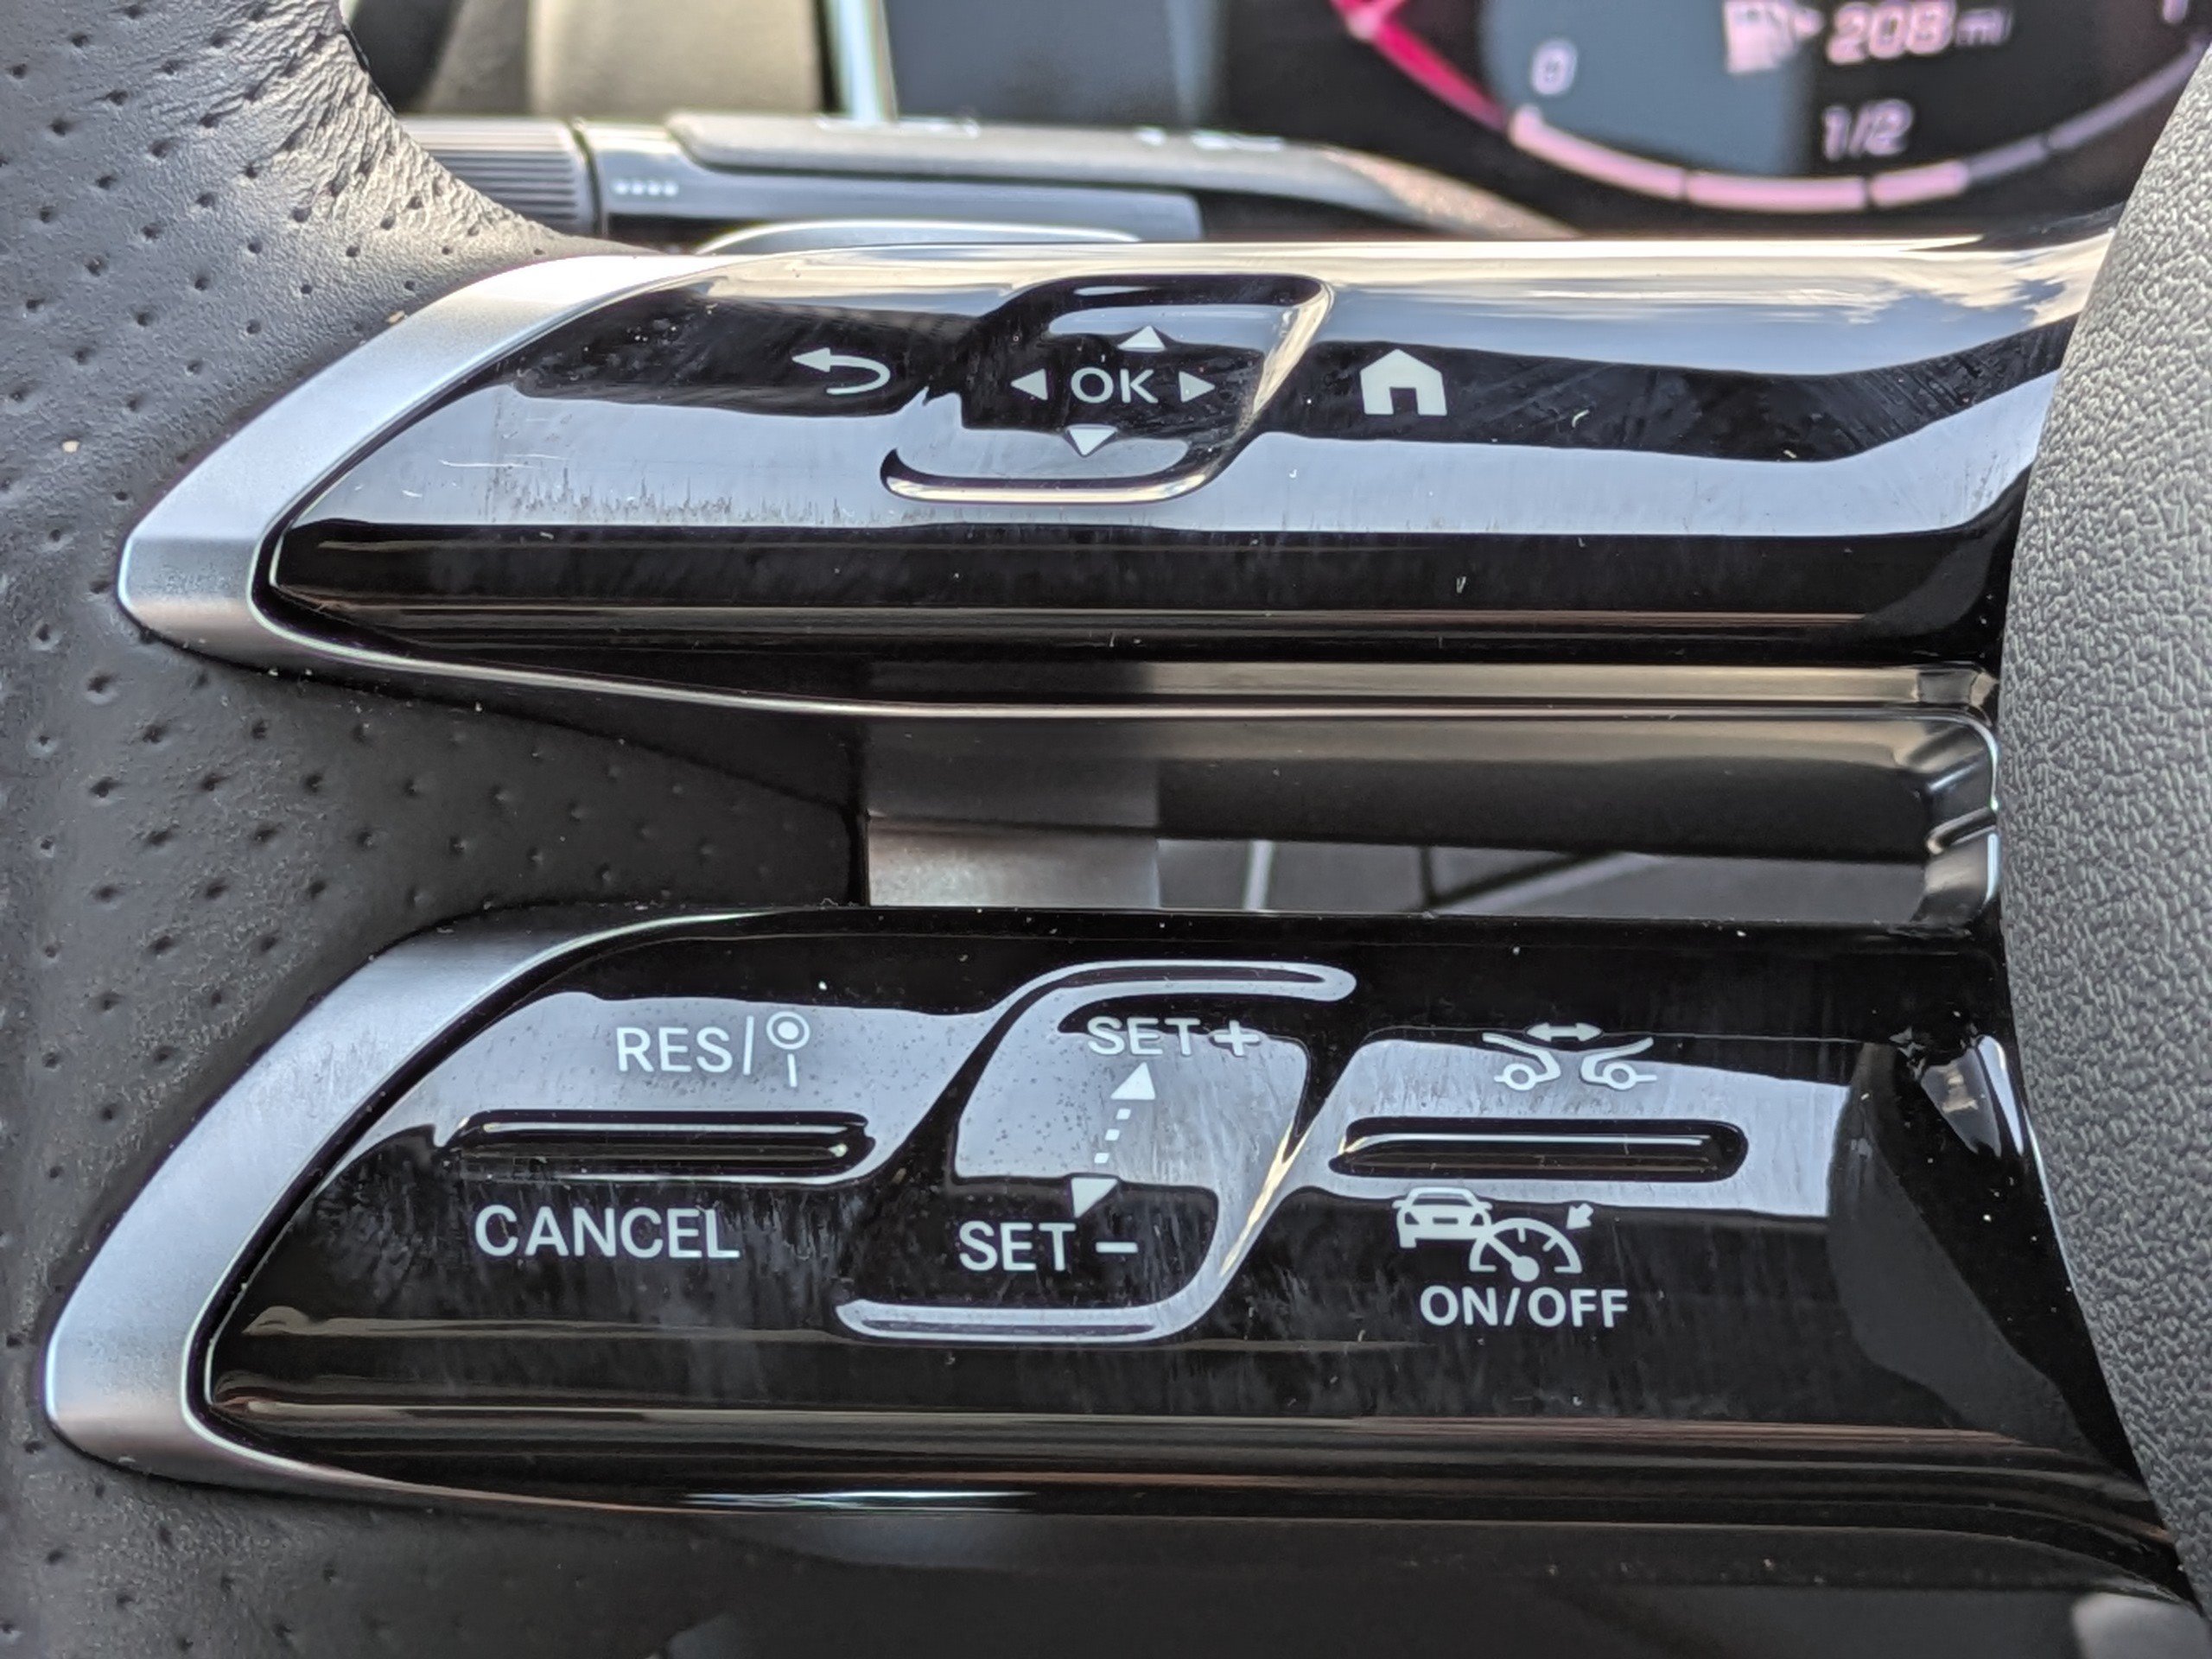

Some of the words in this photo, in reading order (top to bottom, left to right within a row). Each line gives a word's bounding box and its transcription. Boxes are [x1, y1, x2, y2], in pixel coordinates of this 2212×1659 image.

[1827, 0, 1956, 65] 208
[1532, 39, 1578, 95] 0
[1822, 99, 1914, 162] 1/2
[1071, 366, 1159, 404] OK
[474, 1205, 740, 1259] CANCEL
[958, 1220, 1077, 1272] SET
[1420, 1285, 1629, 1328] ON/OFF
